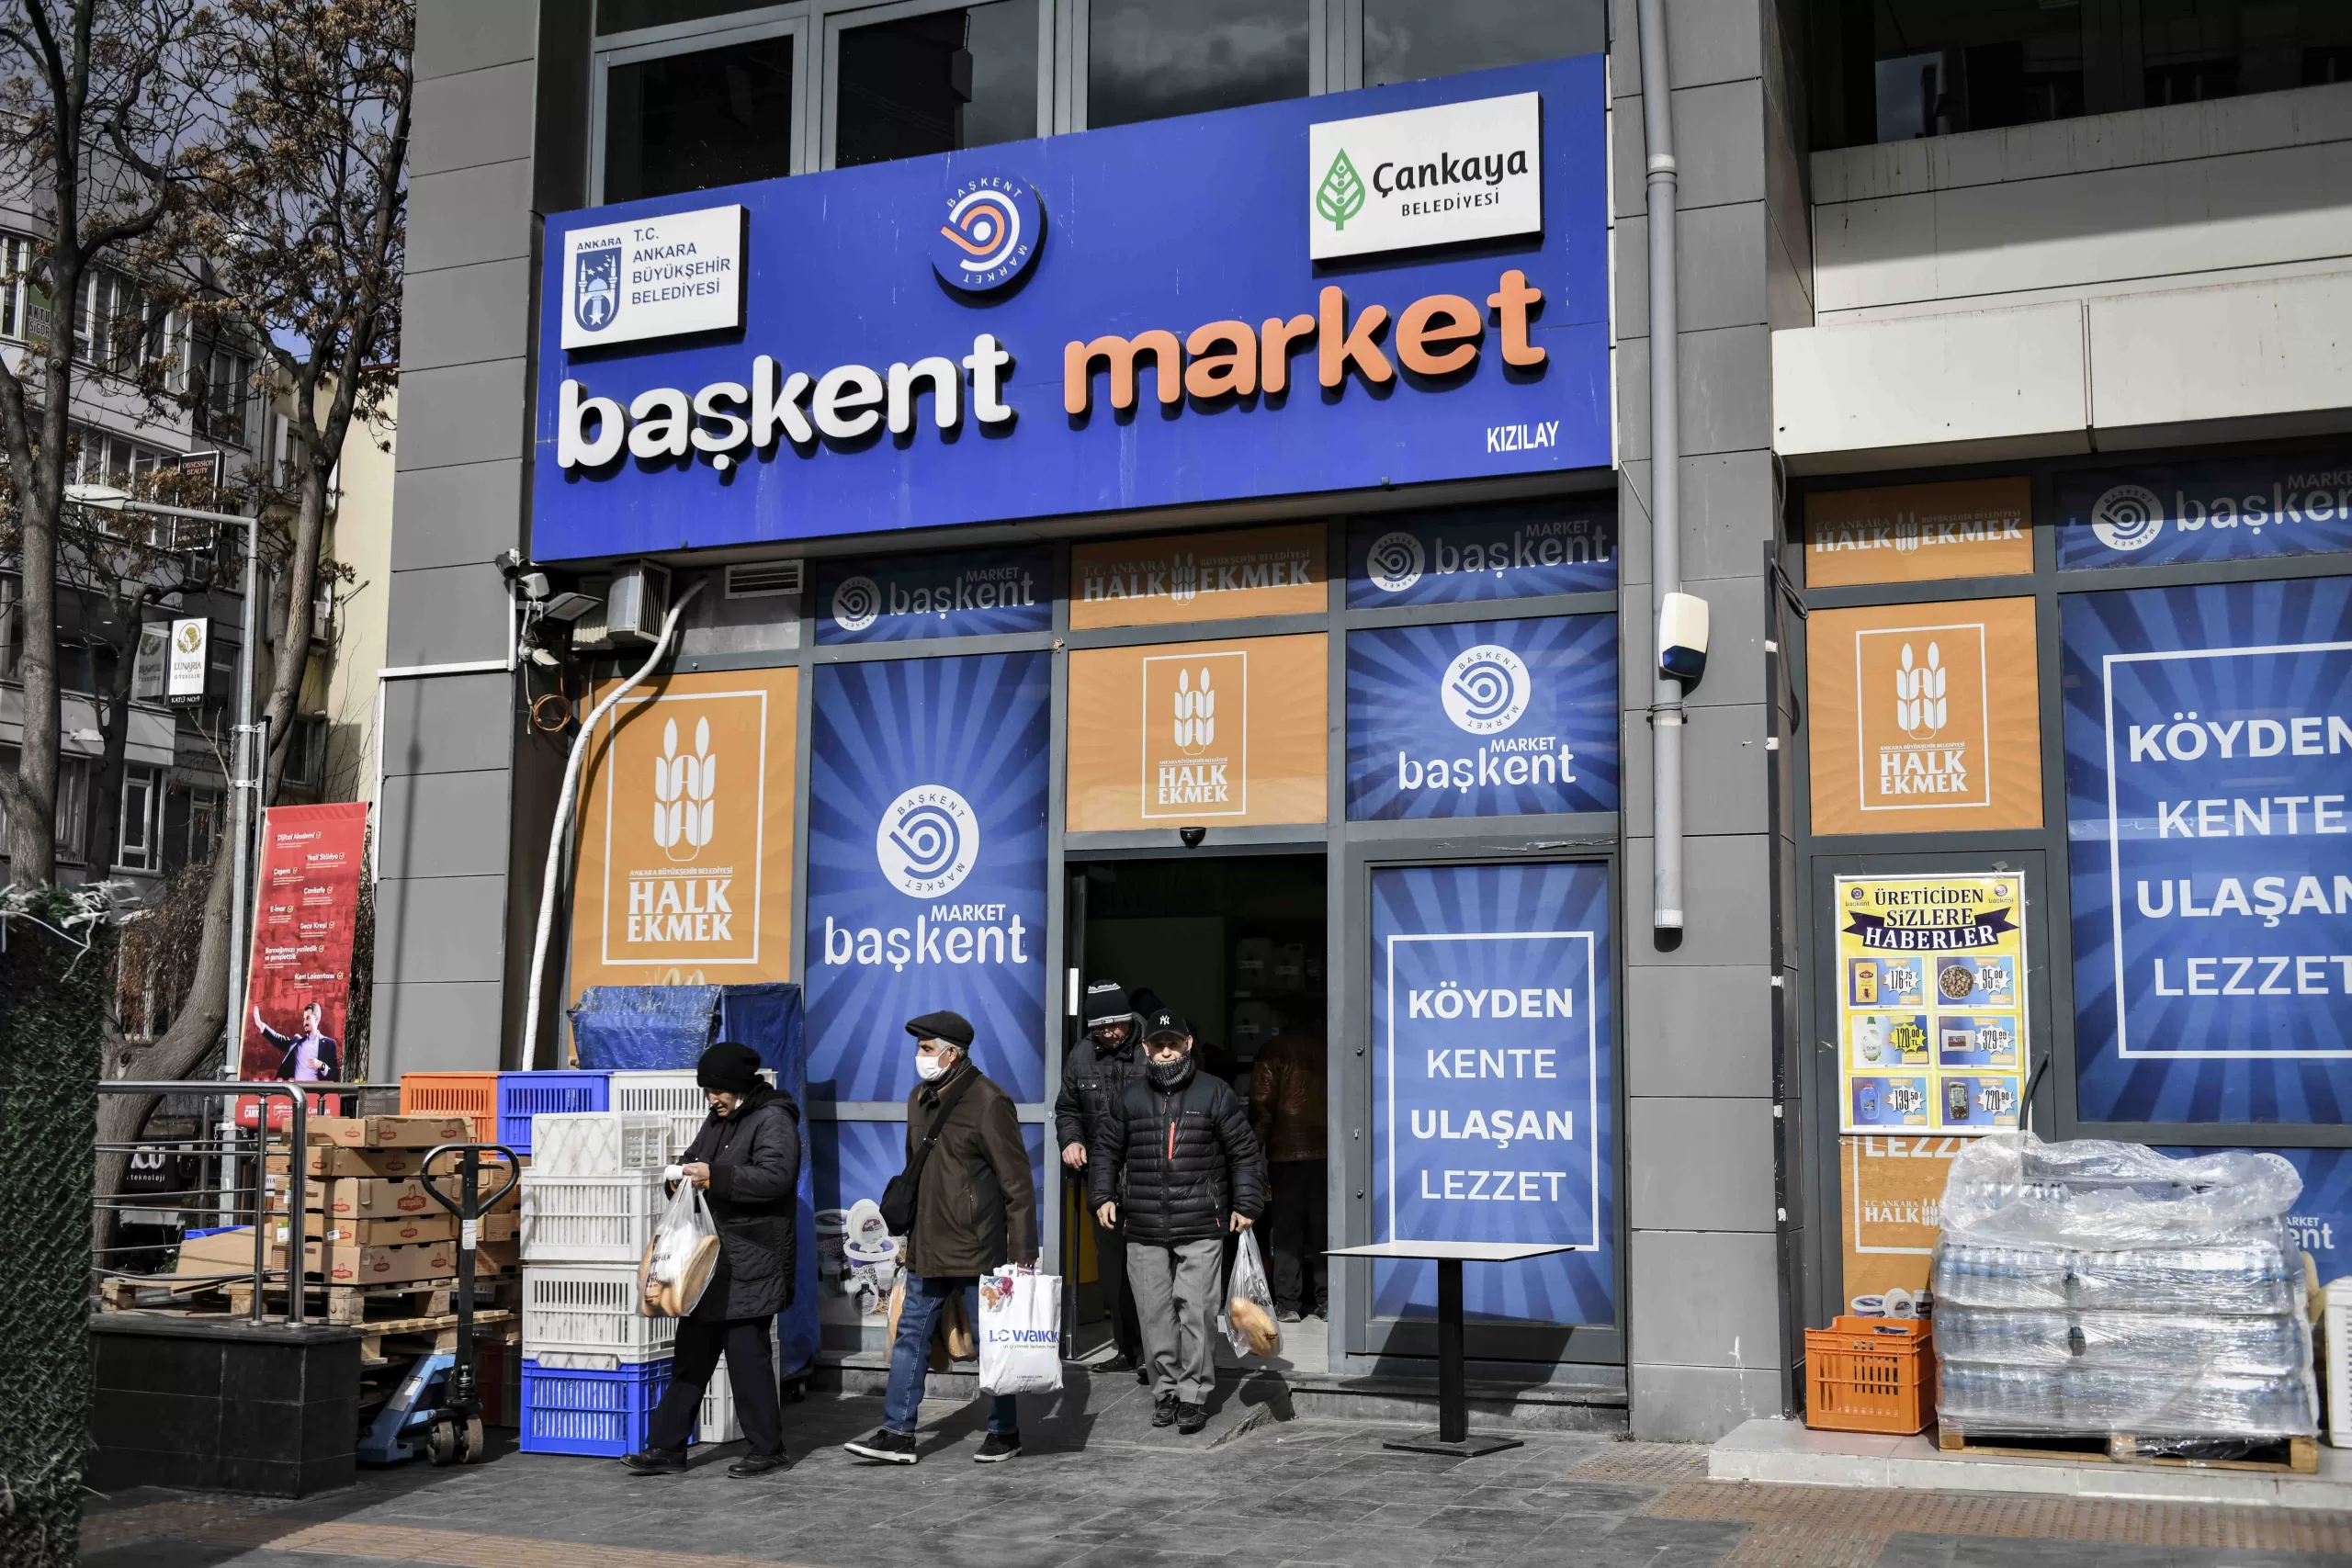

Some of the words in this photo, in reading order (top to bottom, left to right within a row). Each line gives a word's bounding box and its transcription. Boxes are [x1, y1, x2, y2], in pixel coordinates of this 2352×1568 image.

[1372, 148, 1528, 197] Çankaya
[946, 177, 1022, 208] BAŞKENT
[1401, 187, 1500, 218] BELEDİYESİ
[576, 236, 622, 252] ANKARA
[633, 228, 660, 243] T.C.
[632, 243, 697, 264] ANKARA
[963, 244, 1027, 284] MARKET
[632, 254, 730, 285] BÜYÜKŞEHİR
[631, 276, 720, 306] BELEDİYESİ
[557, 333, 1012, 470] başkent
[1064, 270, 1546, 414] market
[1487, 420, 1559, 453] KIZILAY
[1526, 519, 1589, 537] MARKET
[1815, 527, 1893, 553] HALK
[1921, 518, 2023, 546] EKMEK
[1838, 517, 1891, 531] ANKARA
[1109, 558, 1167, 574] ANKARA
[1435, 525, 1610, 579] başkent
[966, 567, 1020, 582] MARKET
[1083, 572, 1168, 603] HALK
[1199, 559, 1313, 593] EKMEK
[889, 571, 1035, 620] başkent
[1458, 650, 1518, 671] BAŞKENT
[1466, 704, 1521, 729] MARKET
[1490, 736, 1555, 752] MARKET
[2129, 711, 2352, 762] KÖYDEN
[1159, 764, 1228, 788] HALK
[1398, 744, 1577, 794] başkent
[1880, 750, 1967, 776] HALK
[1158, 785, 1228, 804] EKMEK
[1880, 773, 1968, 795] EKMEK
[897, 794, 965, 818] BAŞKENT
[2158, 795, 2346, 839] KENTE
[905, 862, 966, 891] MARKET
[628, 879, 732, 915] HALK
[1874, 886, 1984, 905] ÜRETİCİDEN
[931, 904, 1006, 921] MARKET
[627, 914, 733, 942] EKMEK
[1864, 925, 1997, 950] HABERLER
[824, 914, 1028, 972] başkent
[2154, 955, 2352, 996] LEZZET
[1409, 981, 1573, 1019] KÖYDEN
[1427, 1049, 1557, 1079] KENTE
[1411, 1110, 1573, 1148] ULAŞAN
[1421, 1169, 1566, 1201] LEZZET
[1863, 1199, 1879, 1207] T.C.
[1864, 1207, 1920, 1223] HALK
[2287, 1217, 2320, 1226] ARKET
[989, 1329, 1010, 1343] LC
